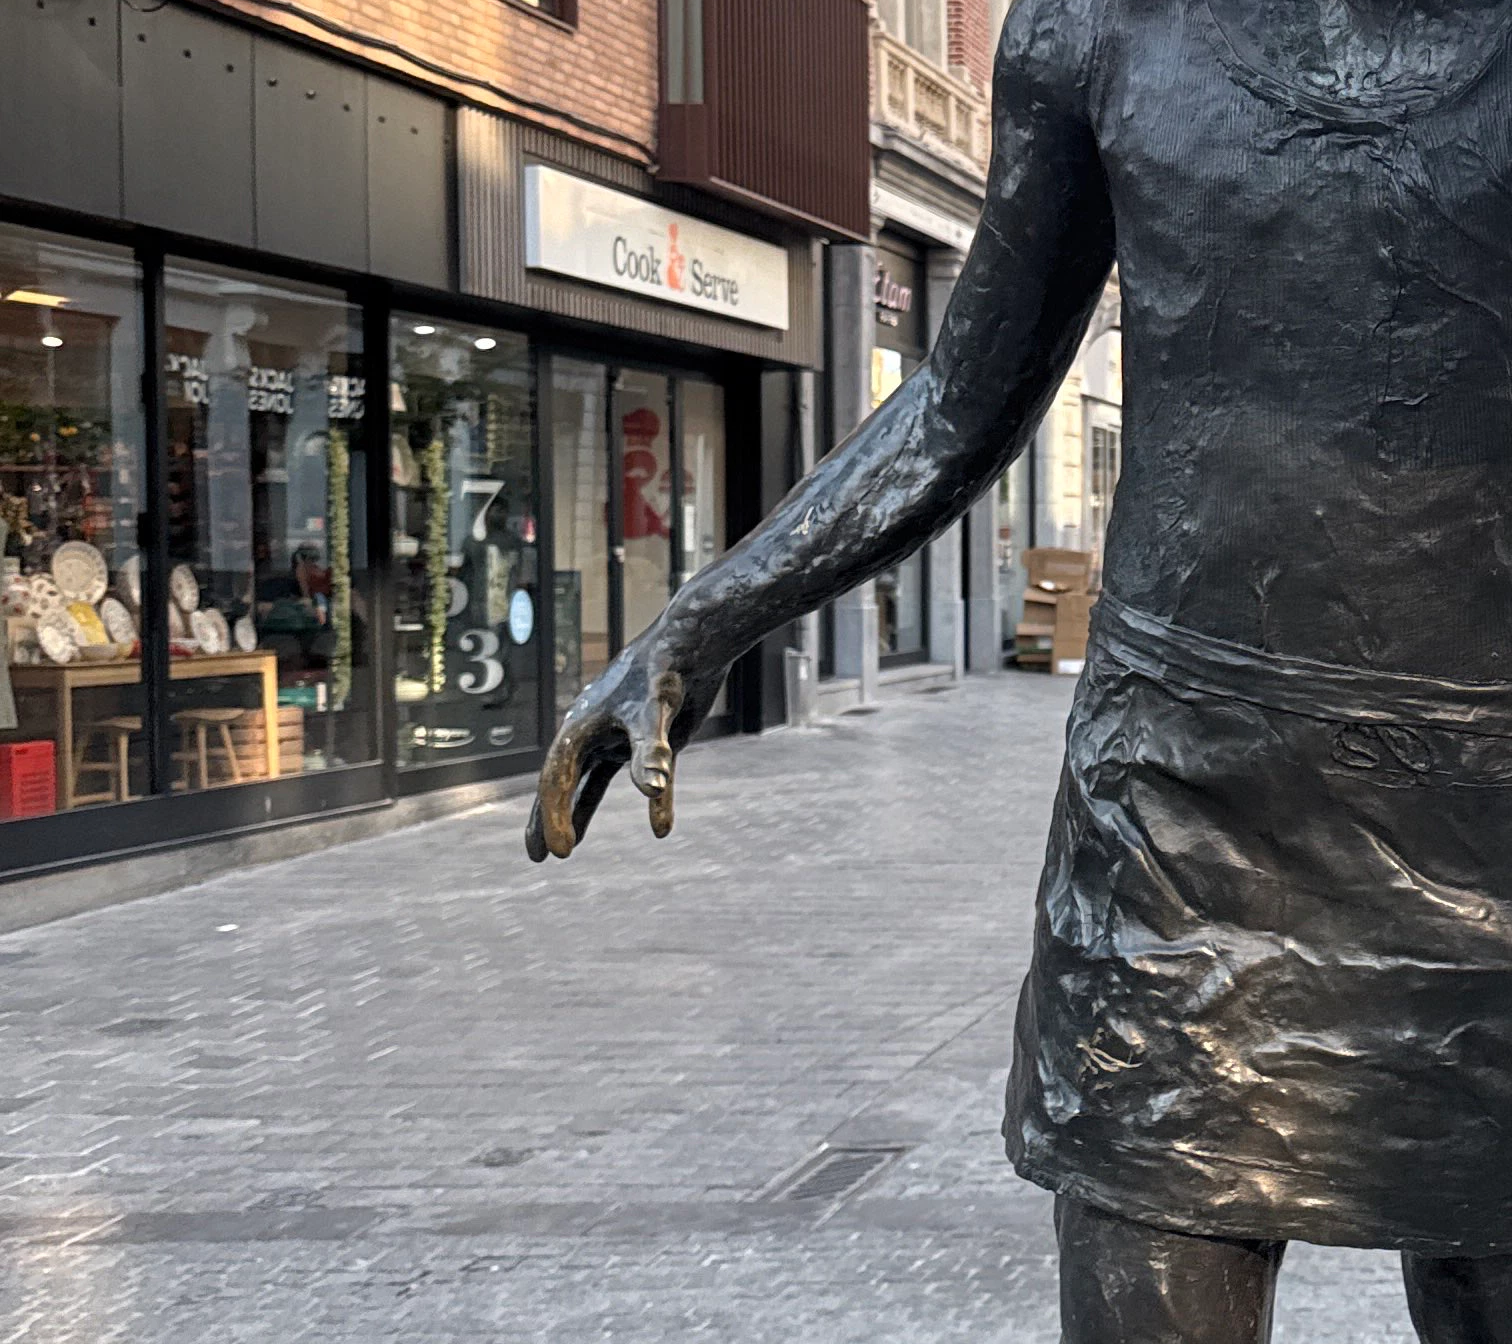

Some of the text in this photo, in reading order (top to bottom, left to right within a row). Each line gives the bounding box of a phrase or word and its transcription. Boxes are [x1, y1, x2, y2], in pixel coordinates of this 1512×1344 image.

[613, 236, 662, 286] Cook
[691, 259, 739, 306] Serve
[460, 479, 505, 542] 7
[458, 628, 504, 694] 3
